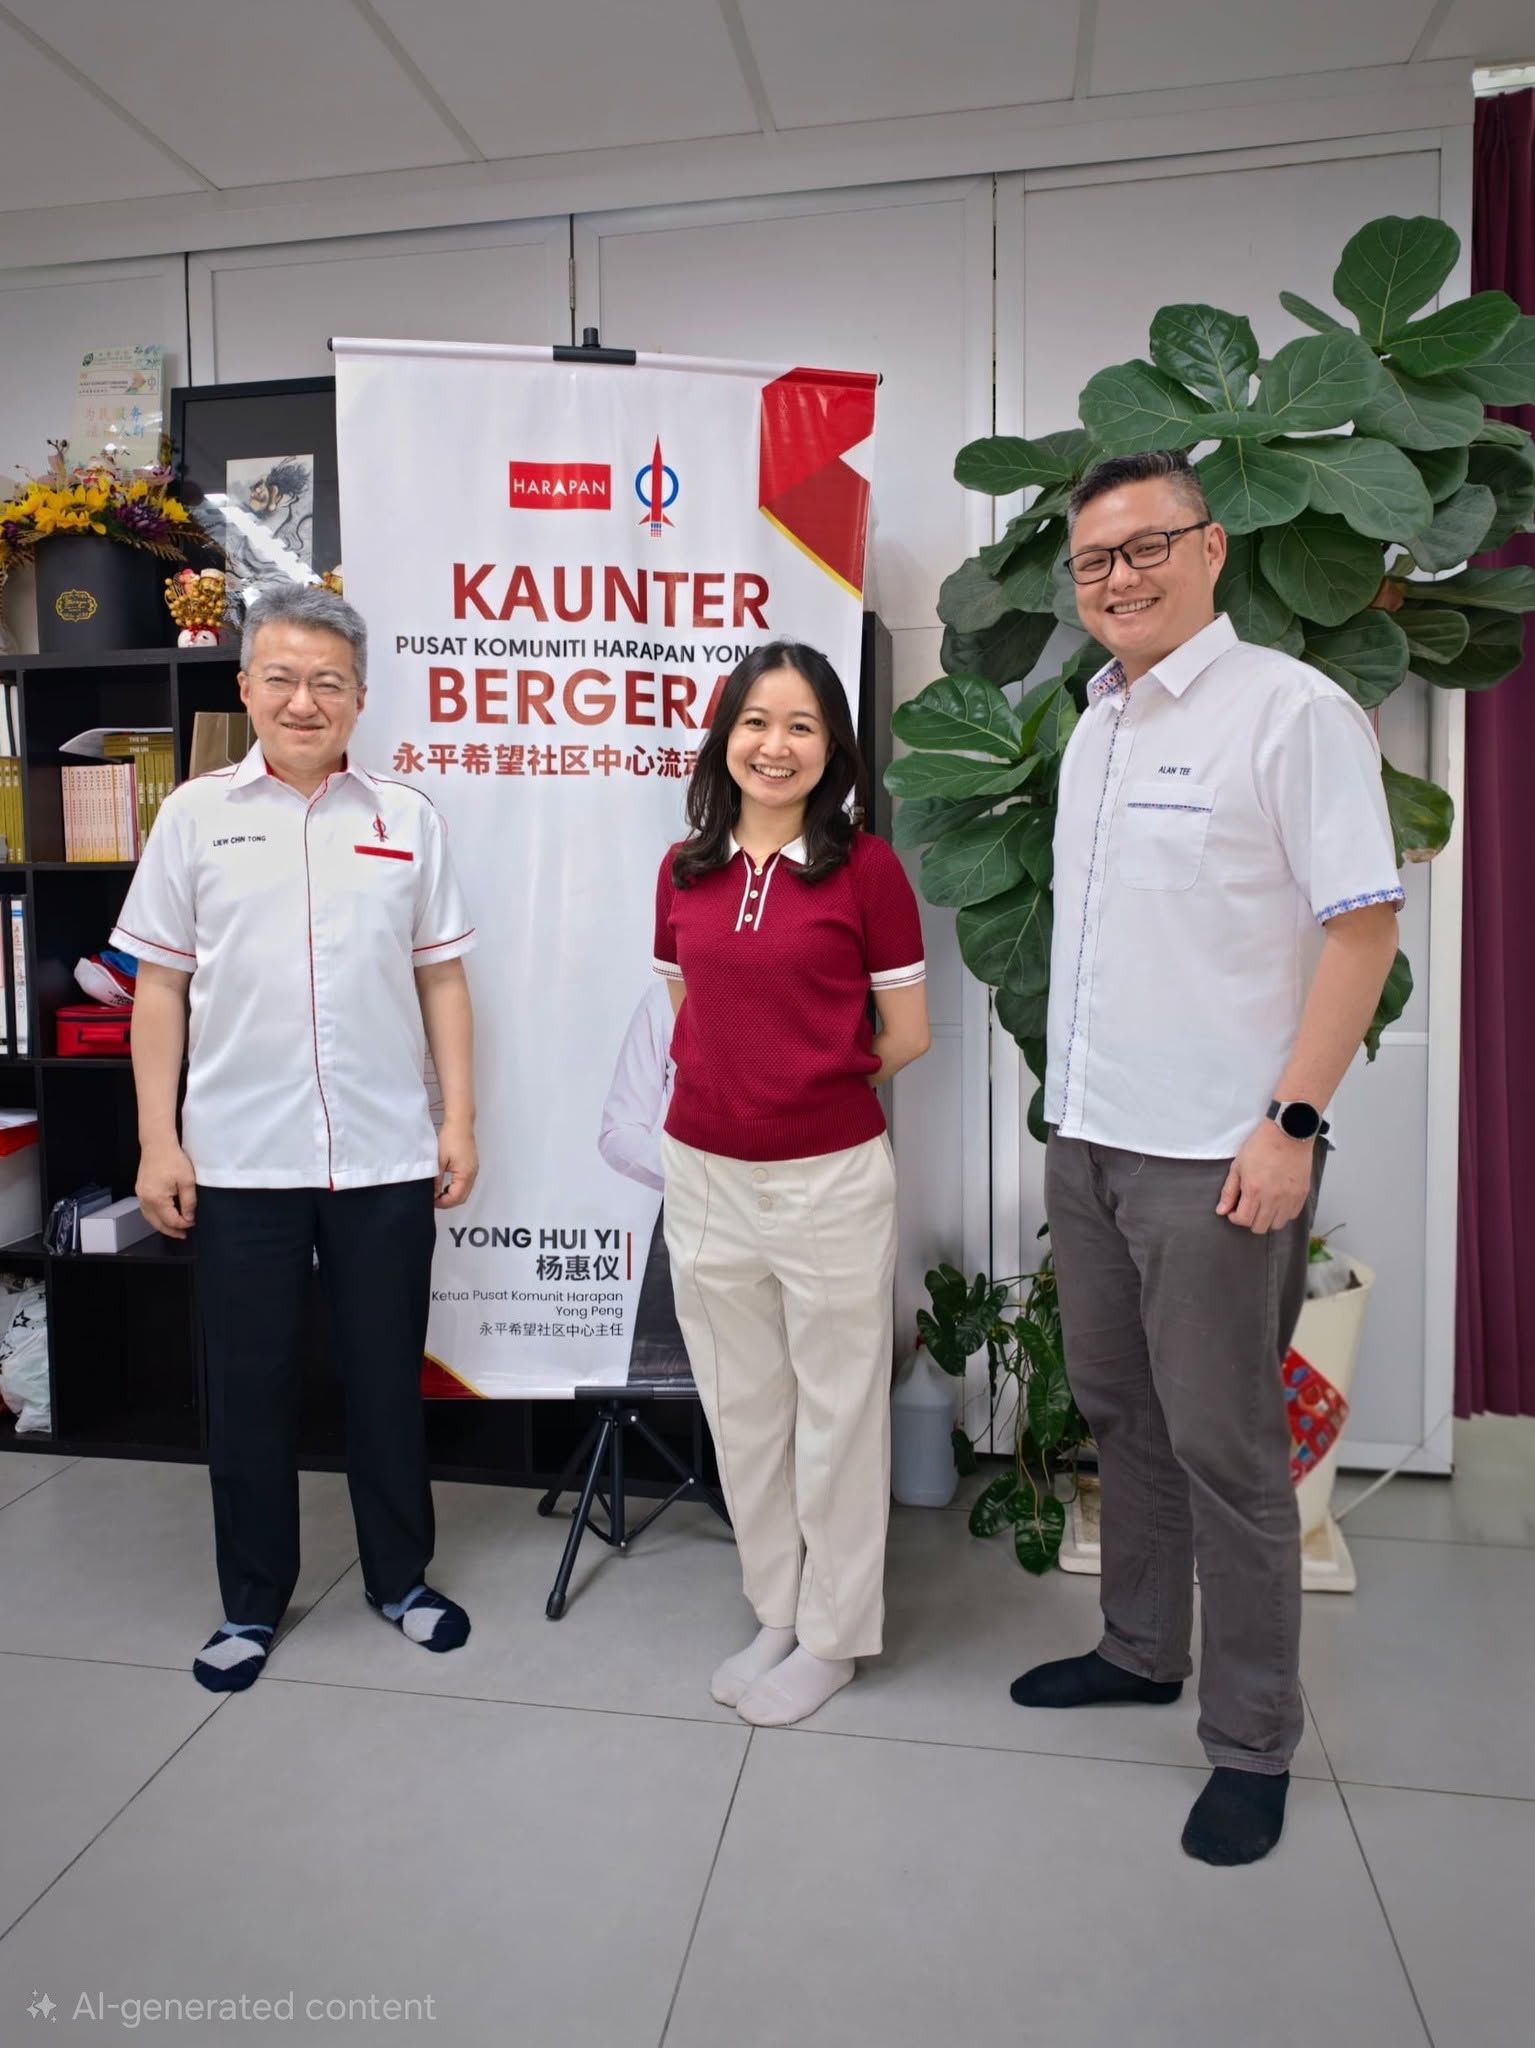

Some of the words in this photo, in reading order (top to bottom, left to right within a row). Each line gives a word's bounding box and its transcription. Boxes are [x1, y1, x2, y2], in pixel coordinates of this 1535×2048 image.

[513, 478, 606, 496] HARAPAN
[453, 563, 770, 630] KAUNTER
[396, 635, 468, 656] PUSAT
[474, 637, 586, 658] KOMUNITI
[593, 639, 695, 663] HARAPAN
[702, 645, 761, 664] YON
[1158, 765, 1176, 775] ALAN
[1179, 767, 1192, 776] TEE
[448, 1226, 532, 1249] YONG
[539, 1228, 587, 1250] HUI
[594, 1228, 620, 1250] YI
[535, 1253, 620, 1282] 杨惠仪
[431, 1290, 469, 1302] Ketua
[472, 1289, 508, 1301] Pusat
[511, 1290, 564, 1302] Komunit
[566, 1291, 623, 1305] Harapan
[555, 1305, 588, 1320] Yong
[591, 1305, 623, 1319] Peng
[479, 1322, 624, 1338] 永平希望社区中心主任
